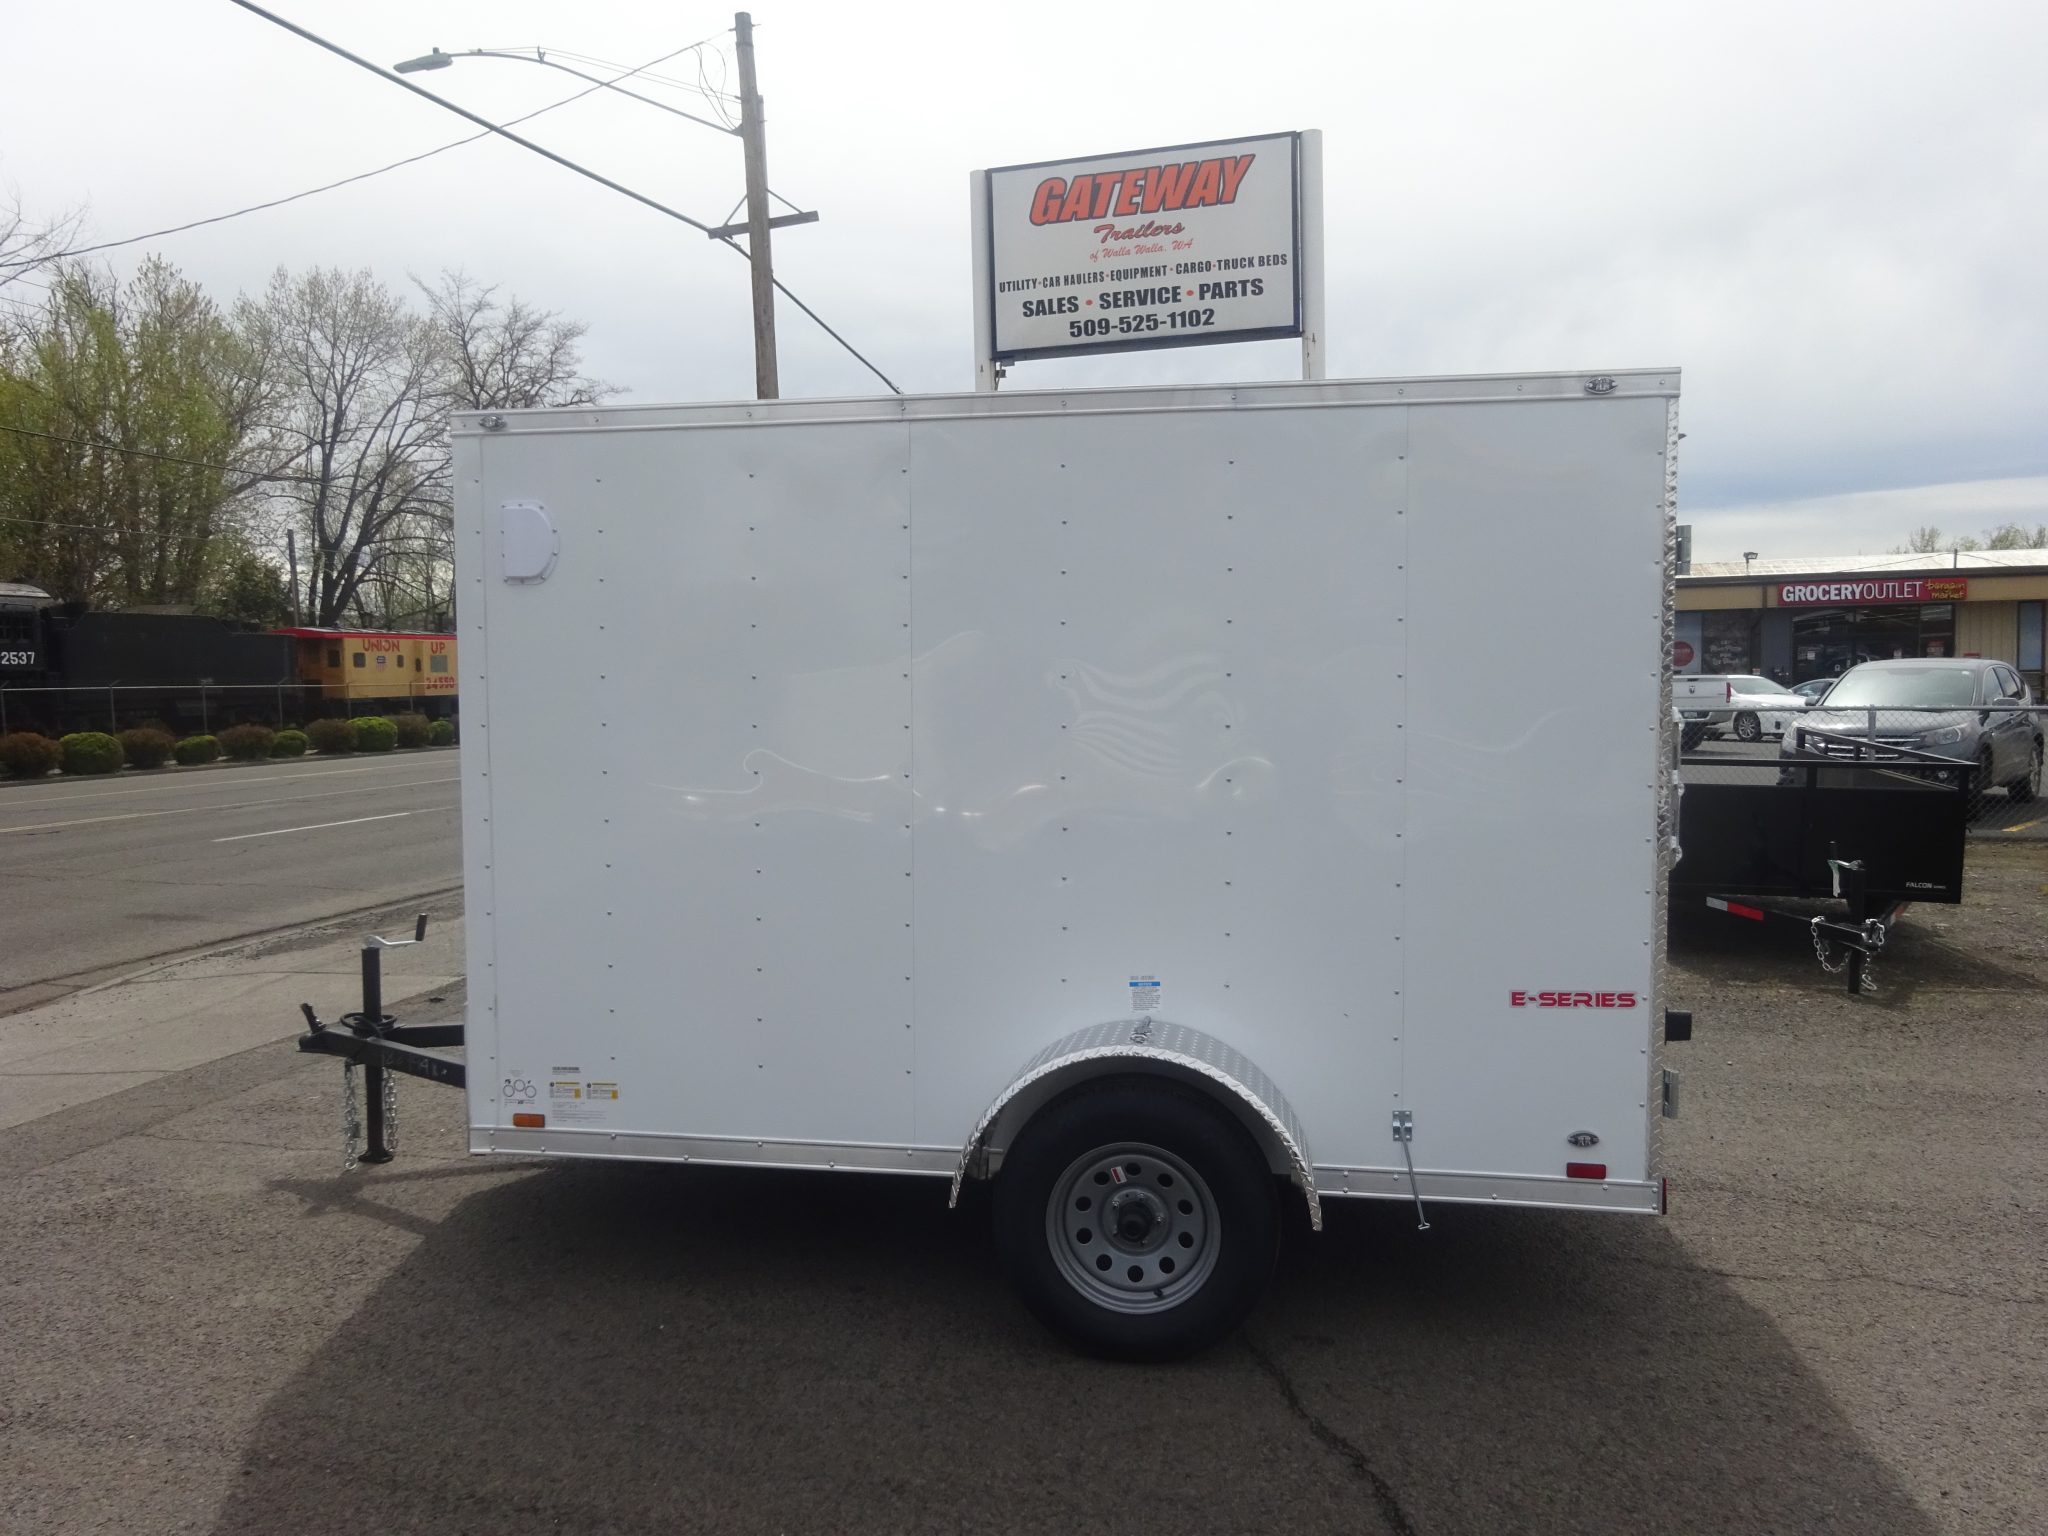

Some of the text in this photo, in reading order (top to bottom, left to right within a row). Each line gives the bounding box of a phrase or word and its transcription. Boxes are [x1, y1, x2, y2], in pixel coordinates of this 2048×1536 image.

[1029, 154, 1256, 226] GATEWAY
[1093, 220, 1185, 243] Trailers
[1089, 250, 1099, 262] of
[1102, 246, 1131, 258] Walla
[1172, 238, 1194, 250] WA
[1258, 253, 1288, 267] BEDS
[1022, 278, 1264, 318] SALES SERVICE PARTS
[1069, 308, 1215, 338] 509-525-1102
[362, 638, 401, 653] UNION
[430, 641, 446, 655] UP
[0, 651, 35, 665] 2537
[1905, 881, 1933, 889] FALCON
[1510, 991, 1637, 1008] E-SERIES
